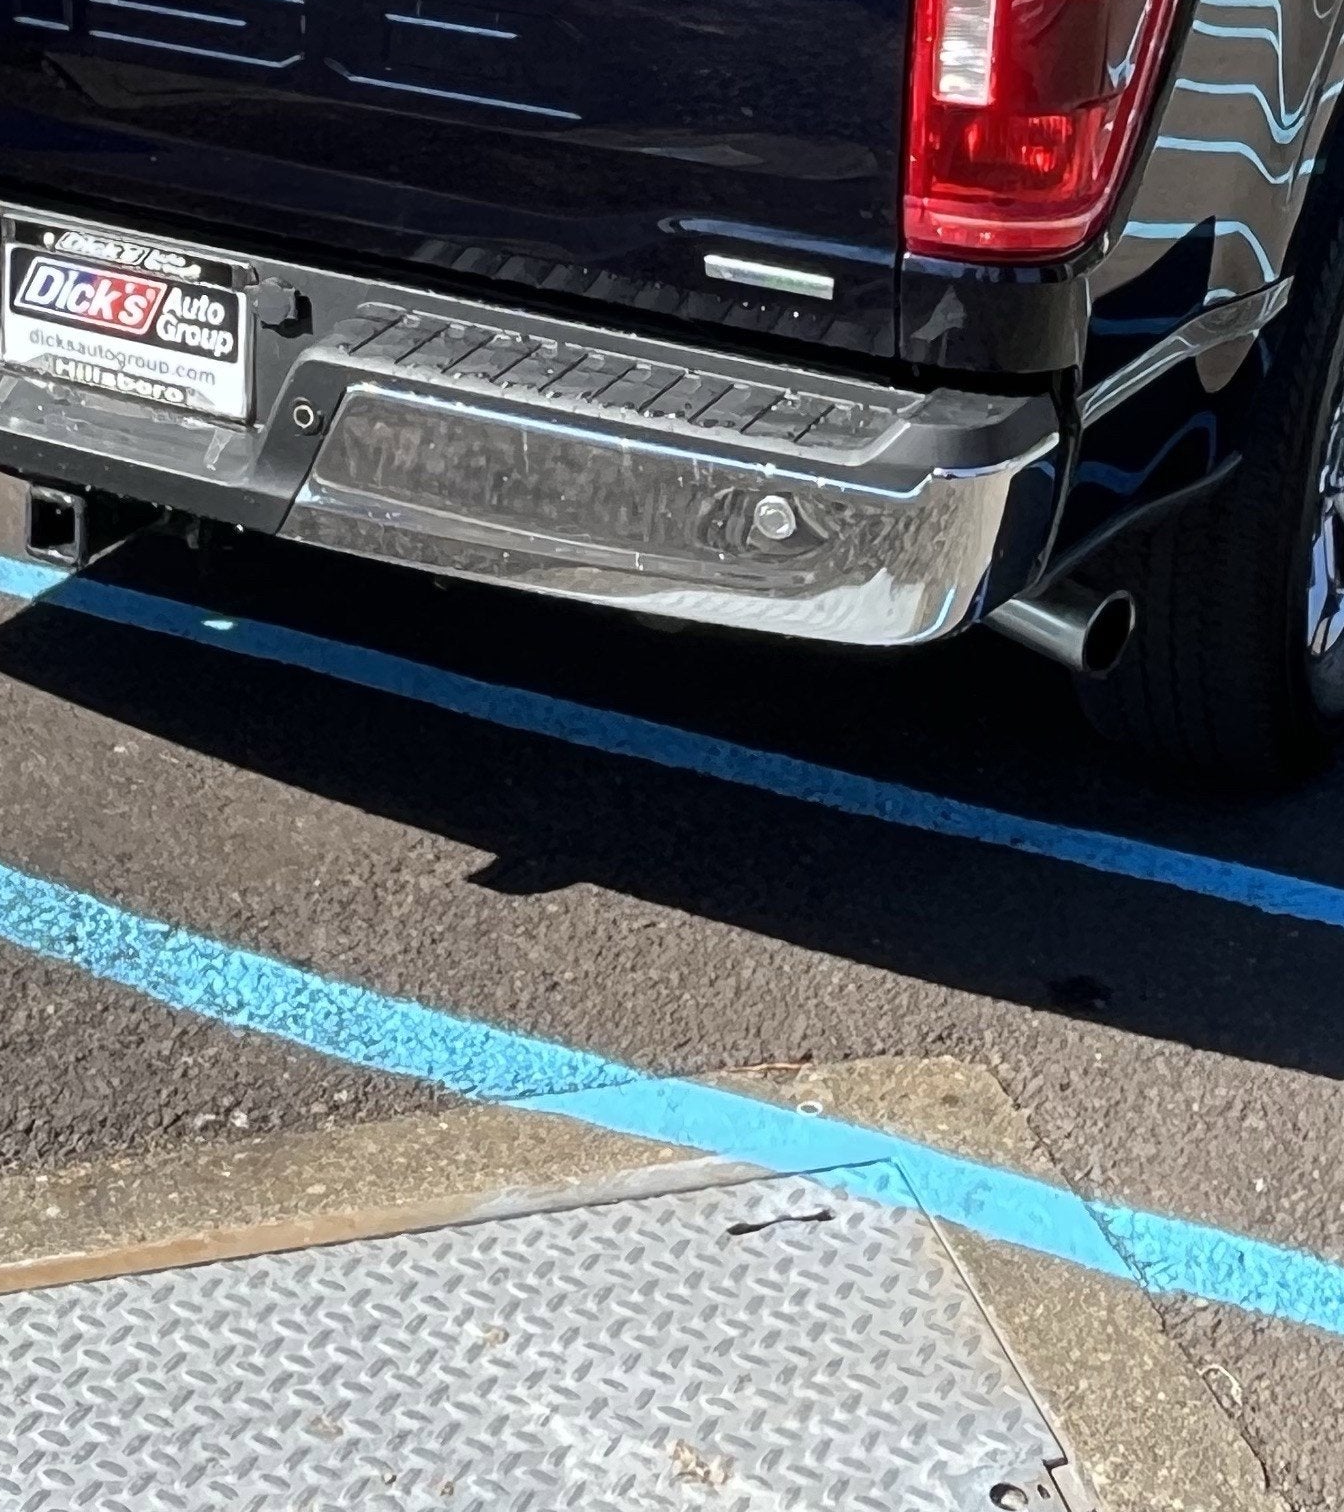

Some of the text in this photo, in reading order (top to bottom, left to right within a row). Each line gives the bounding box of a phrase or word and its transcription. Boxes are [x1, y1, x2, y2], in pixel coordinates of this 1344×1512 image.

[163, 287, 226, 326] Auto
[29, 327, 217, 387] dicksautogroup.com
[156, 314, 235, 358] Group
